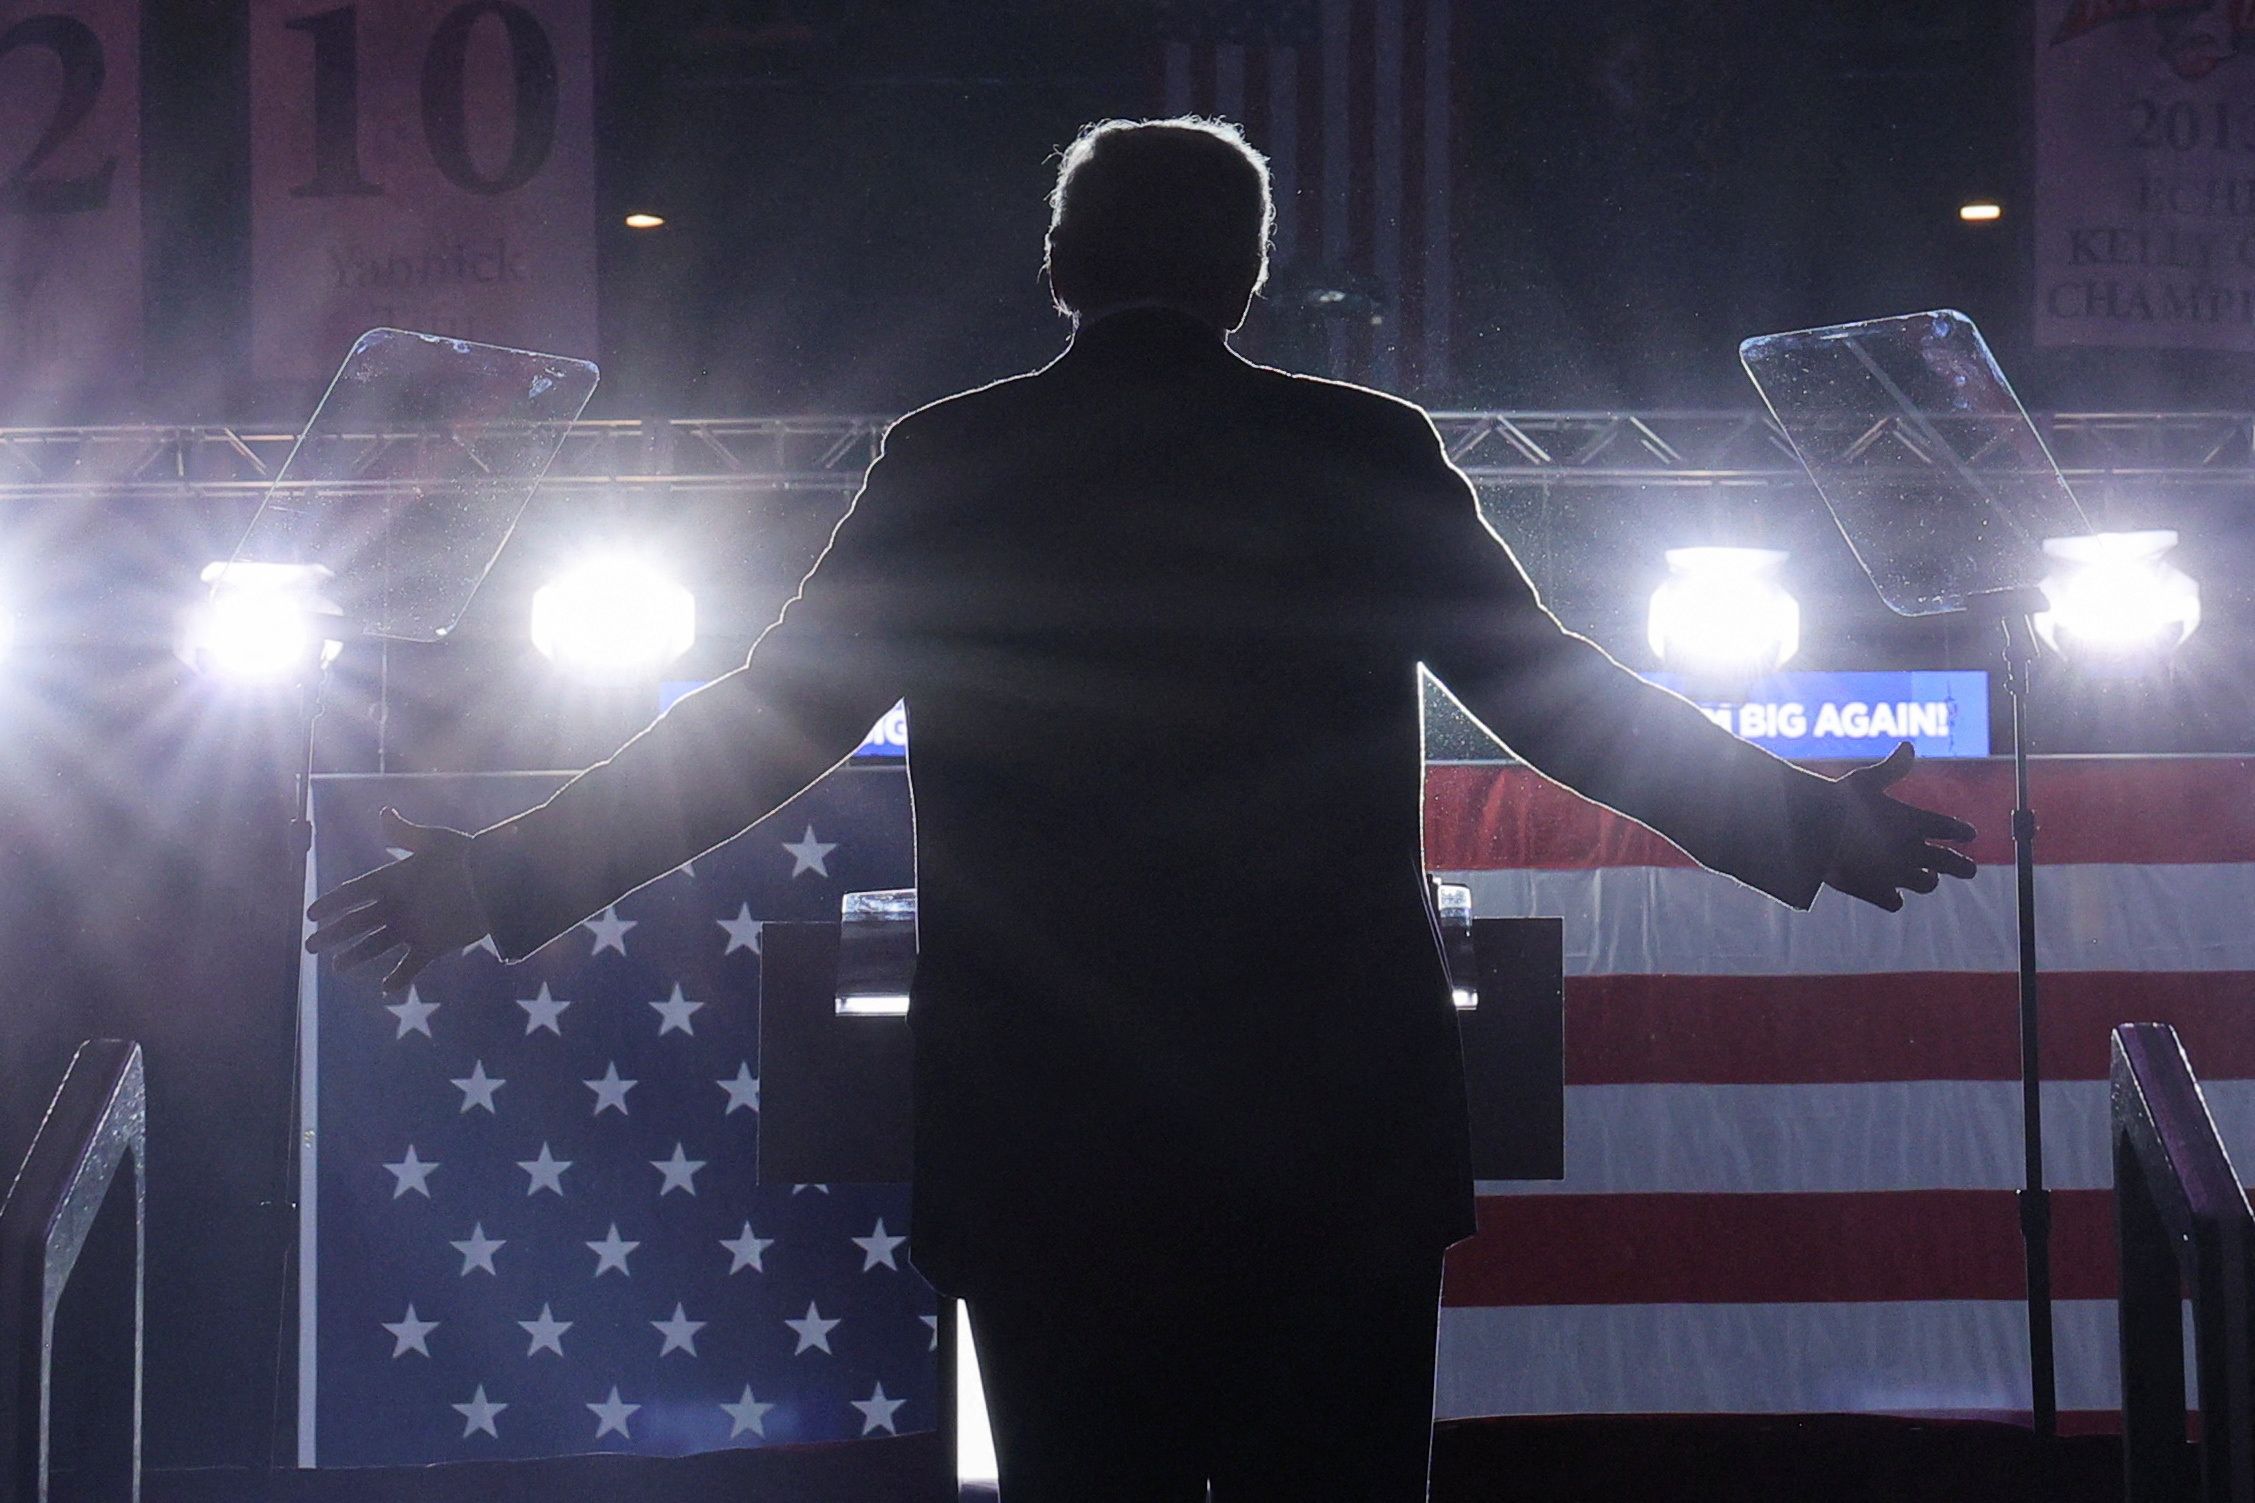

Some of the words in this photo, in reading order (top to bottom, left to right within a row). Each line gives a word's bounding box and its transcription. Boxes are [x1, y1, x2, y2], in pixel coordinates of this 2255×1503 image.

[285, 2, 558, 196] 10
[866, 709, 907, 746] IG
[1739, 702, 1807, 738] BIG
[1813, 701, 1949, 738] AGAIN!
